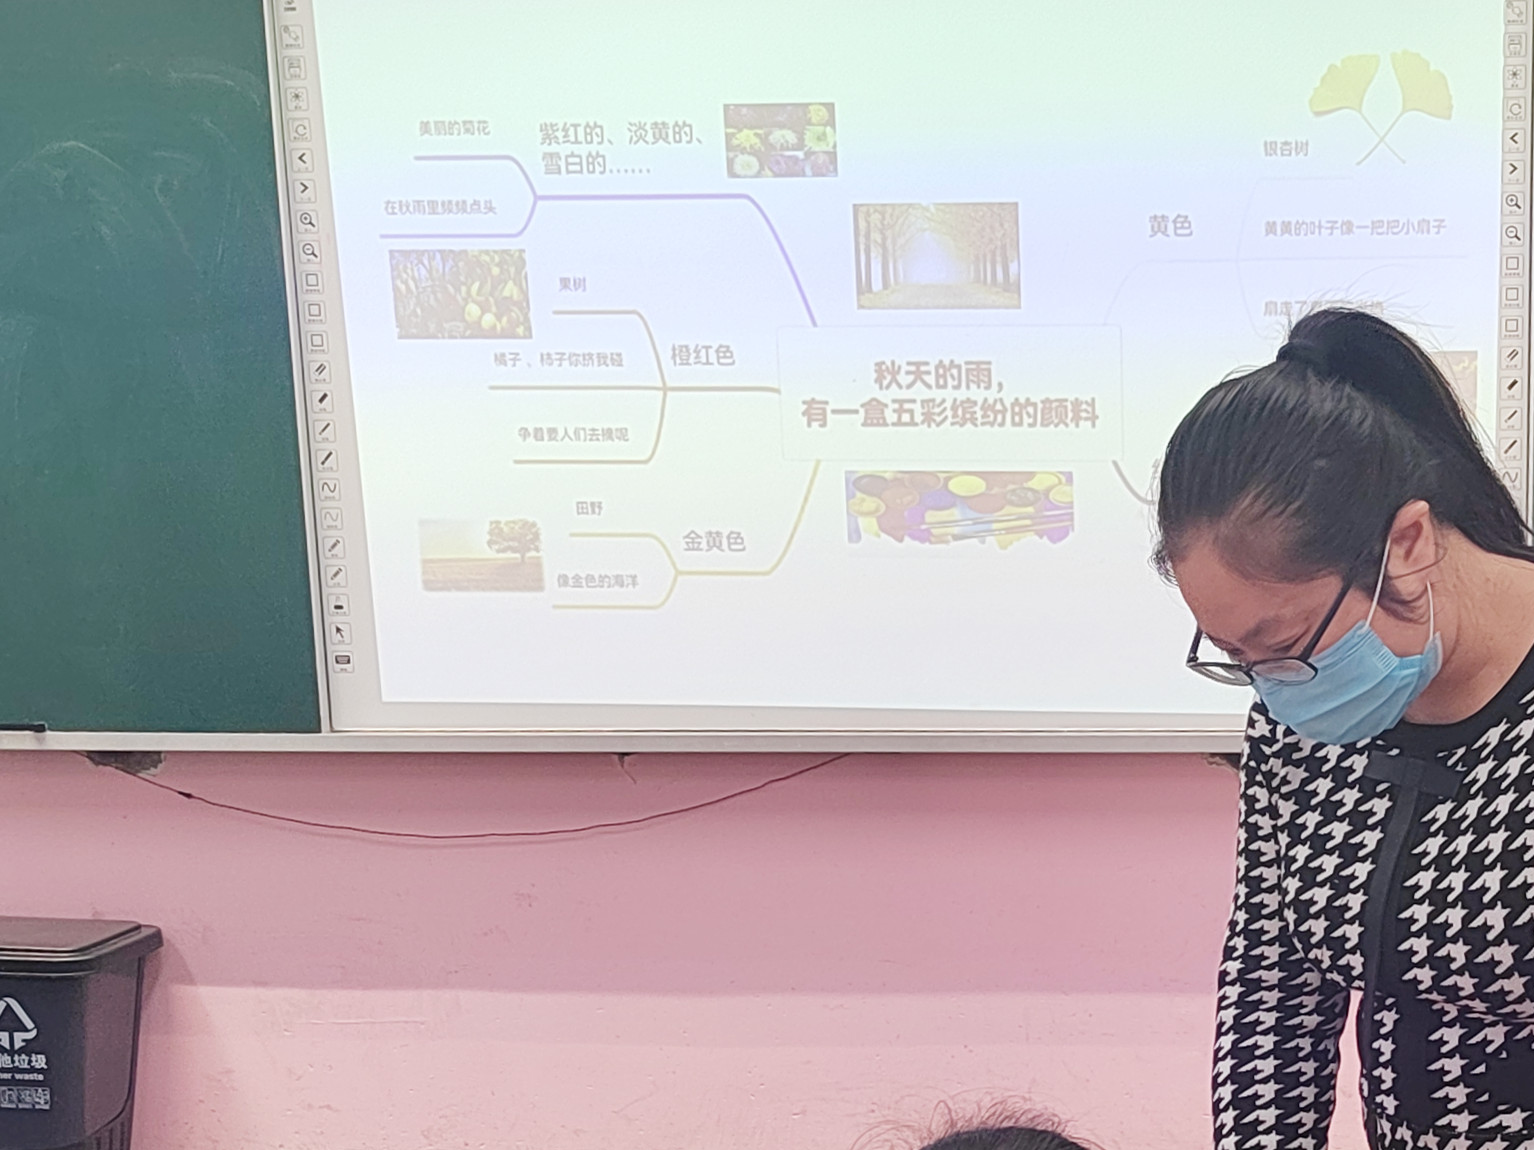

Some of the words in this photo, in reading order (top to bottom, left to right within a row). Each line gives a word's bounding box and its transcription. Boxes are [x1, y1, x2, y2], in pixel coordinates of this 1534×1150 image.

[418, 120, 491, 137] 美丽的菊花
[538, 120, 704, 147] 紫红的、淡黄的、
[1263, 139, 1310, 158] 银杏树
[1148, 213, 1194, 239] 黄色
[1264, 218, 1447, 238] 黄黄的叶子像一把把小扇子
[558, 276, 587, 293] 果树
[670, 344, 736, 367] 橙红色
[801, 397, 1100, 429] 有一盒五彩缤纷的颜料
[575, 501, 603, 516] 田野
[682, 530, 746, 553] 金黄色
[556, 574, 639, 590] 像金色的海洋
[14, 1072, 45, 1081] waste
